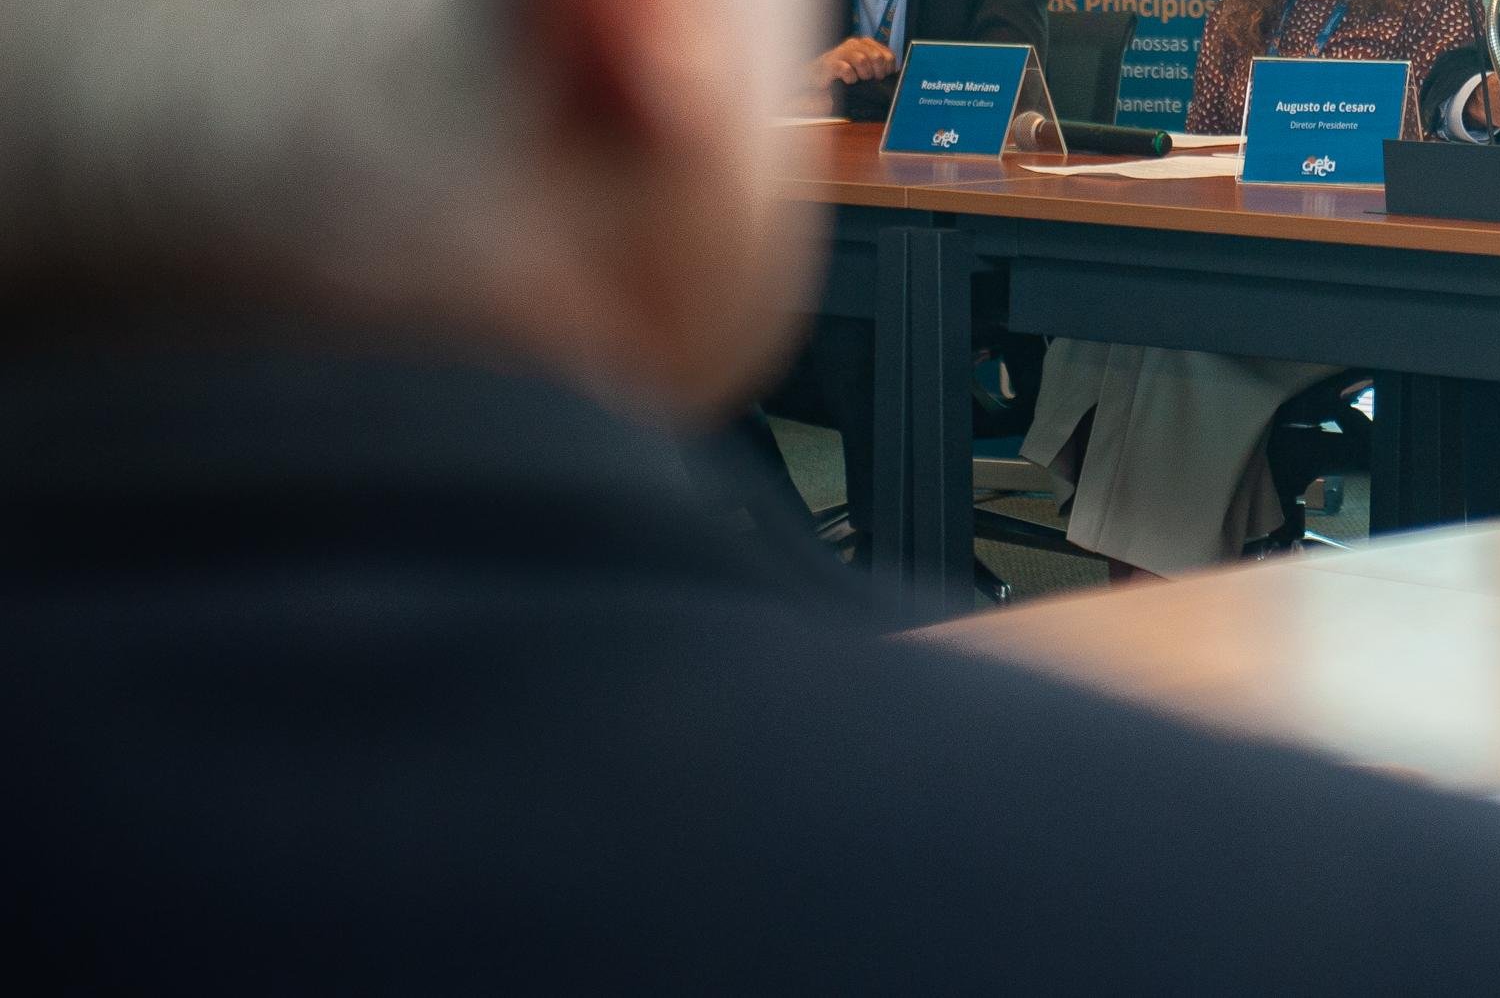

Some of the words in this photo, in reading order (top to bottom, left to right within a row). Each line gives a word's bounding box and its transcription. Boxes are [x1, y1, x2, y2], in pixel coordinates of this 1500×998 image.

[1132, 38, 1188, 52] nossas
[921, 80, 963, 93] Rosângela
[965, 82, 1000, 92] Mariano
[1276, 101, 1320, 114] Augusto
[1322, 102, 1336, 112] de
[1339, 102, 1376, 113] Cesaro
[1290, 121, 1316, 129] Diretor
[1318, 121, 1358, 129] Presidente
